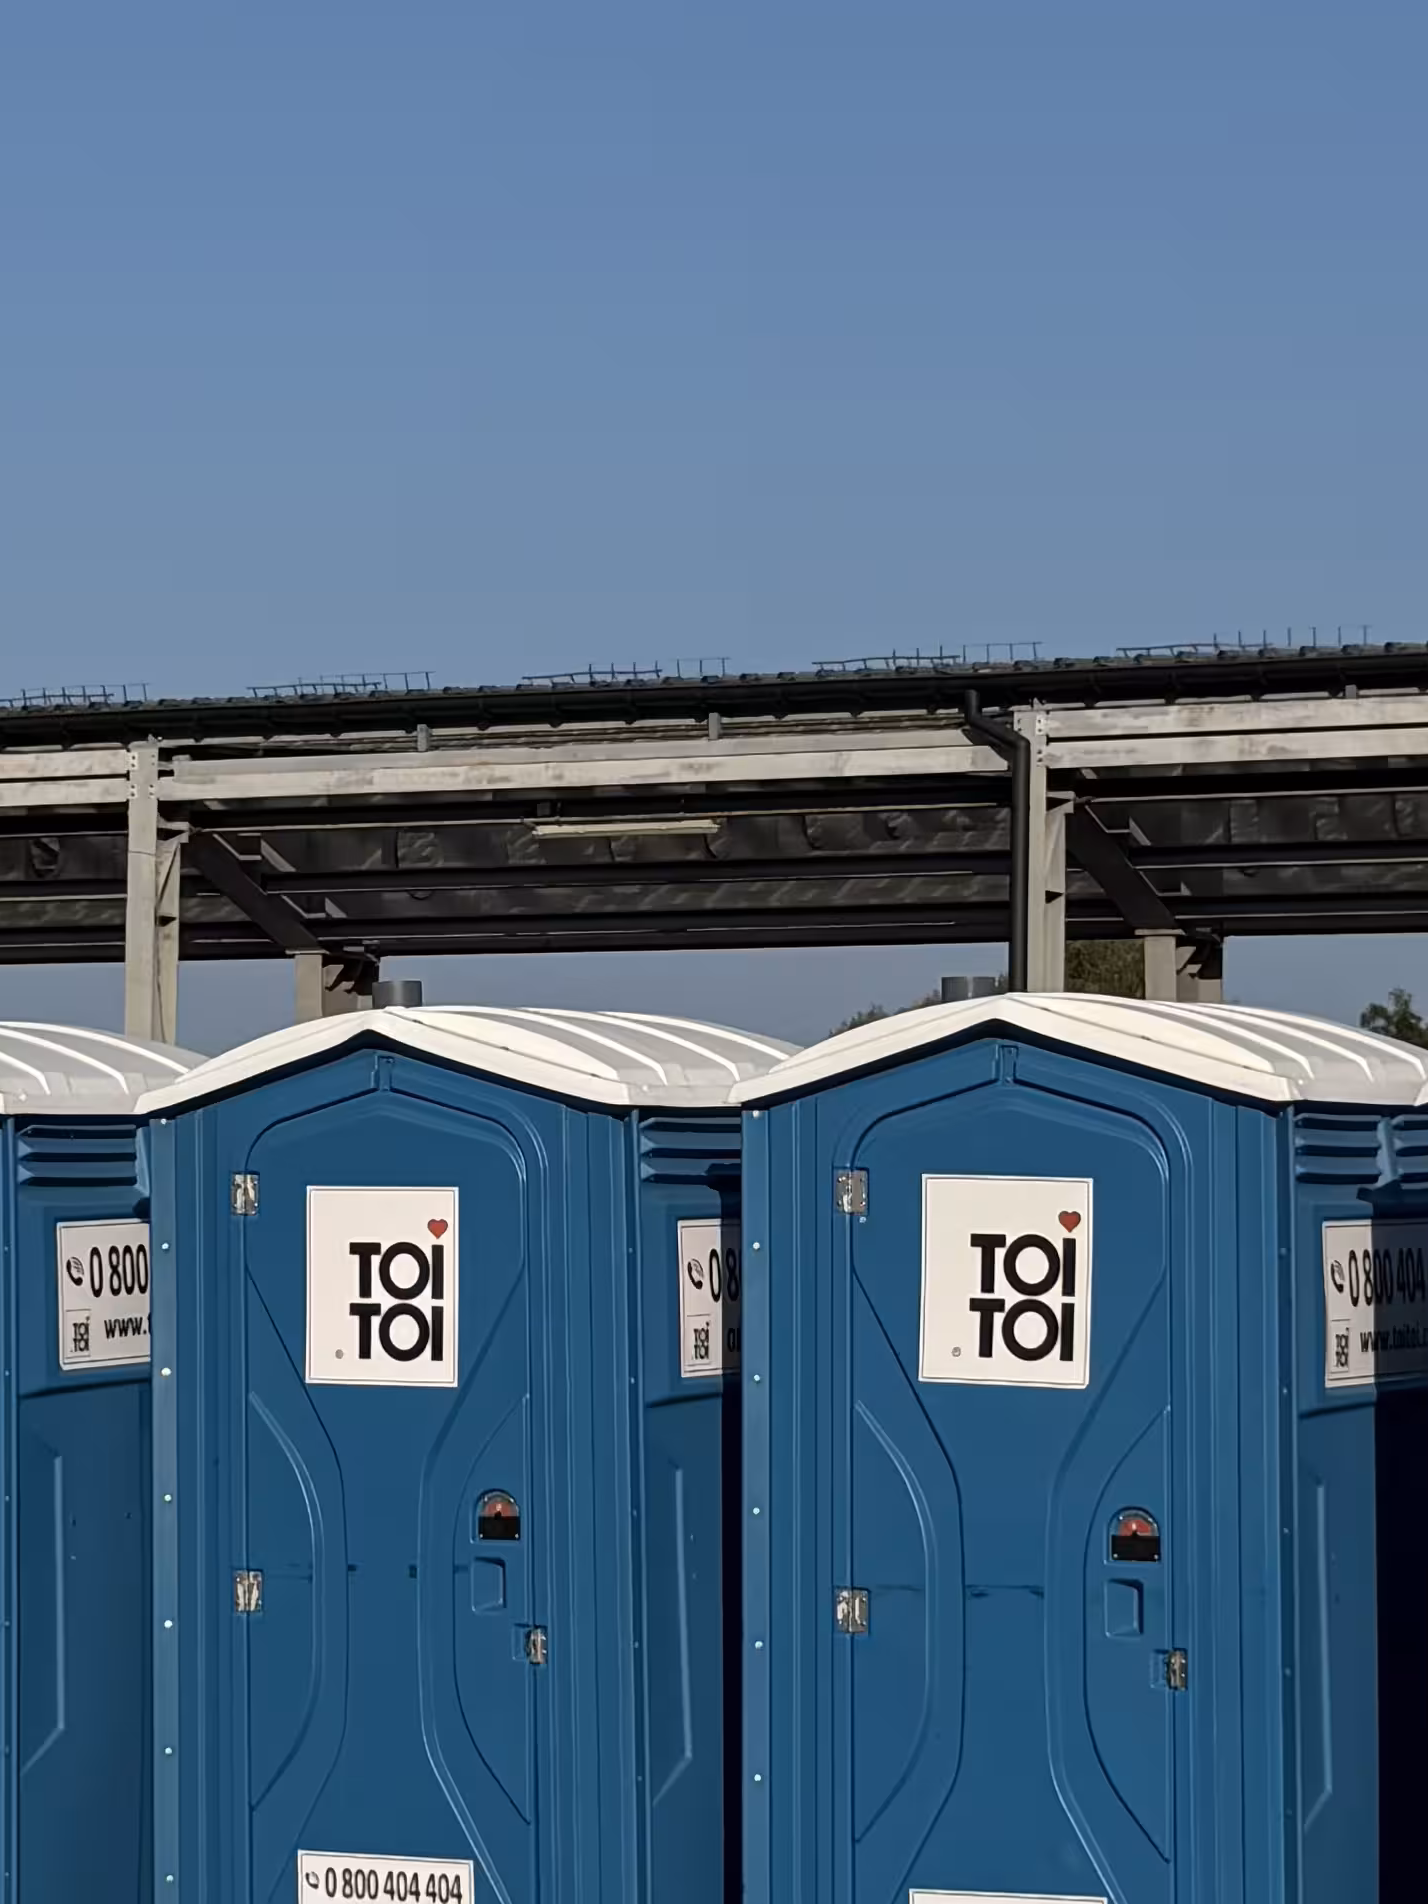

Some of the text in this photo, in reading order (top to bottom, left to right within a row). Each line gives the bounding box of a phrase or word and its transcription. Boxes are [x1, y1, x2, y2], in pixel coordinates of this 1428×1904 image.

[90, 1244, 149, 1298] 0 800
[350, 1241, 444, 1300] TOI
[709, 1248, 722, 1303] 0
[970, 1234, 1076, 1297] TOI
[1348, 1249, 1360, 1308] 0
[1362, 1249, 1393, 1306] 800
[349, 1303, 444, 1362] TOI
[969, 1298, 1075, 1361] TOI
[325, 1867, 462, 1904] 0 800 404 404
